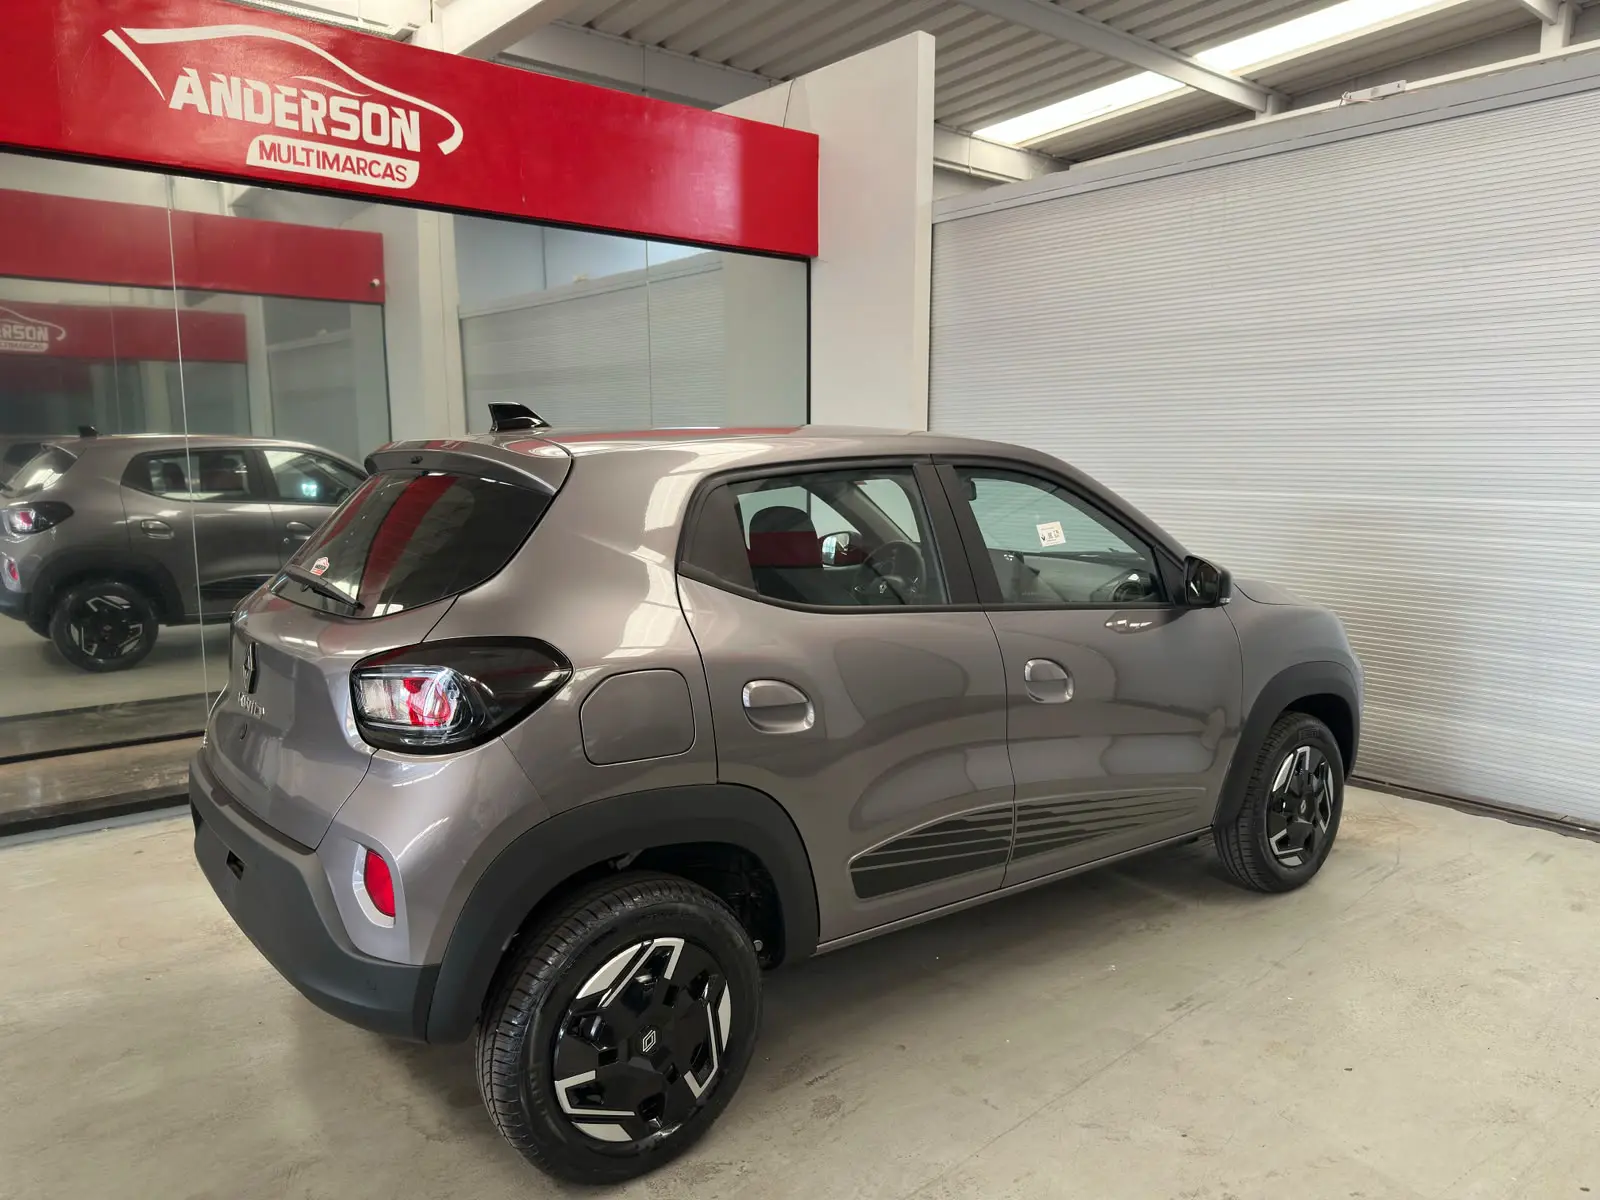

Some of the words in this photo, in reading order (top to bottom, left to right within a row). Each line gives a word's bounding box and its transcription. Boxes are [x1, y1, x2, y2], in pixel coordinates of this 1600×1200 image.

[169, 67, 420, 152] ANDERSON
[259, 140, 407, 183] MULTIMARCAS
[0, 324, 48, 341] RSON
